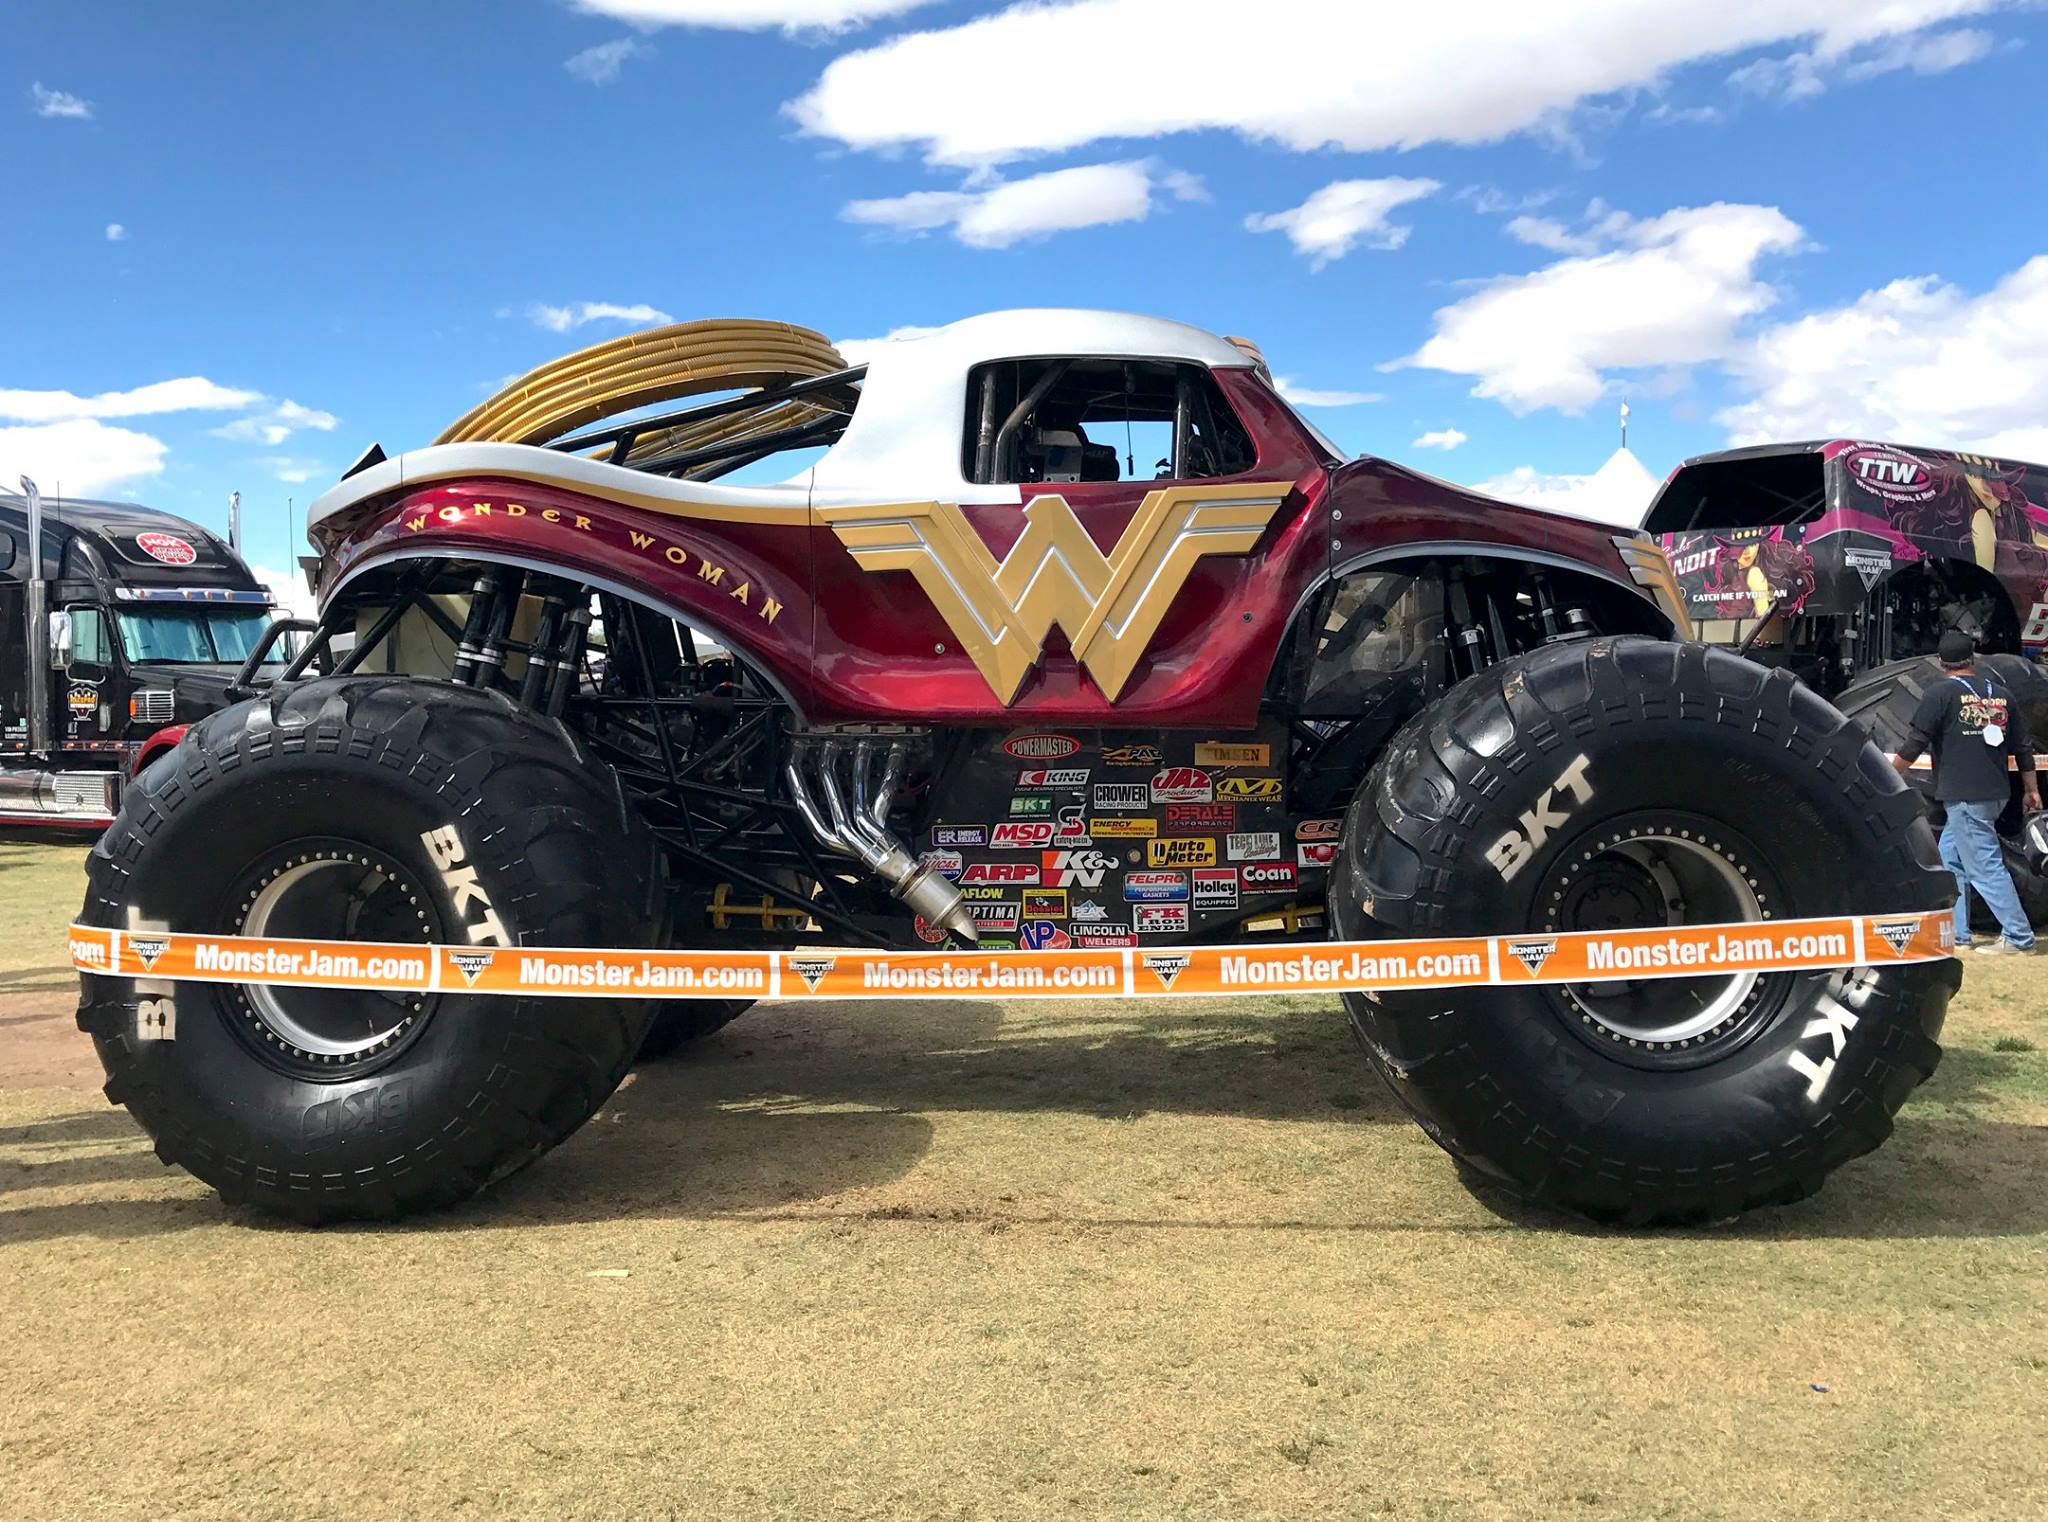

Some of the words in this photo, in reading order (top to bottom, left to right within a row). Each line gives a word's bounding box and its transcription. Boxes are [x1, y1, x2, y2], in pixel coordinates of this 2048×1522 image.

[1858, 458, 1918, 484] TTW
[406, 503, 592, 533] WONDER
[628, 530, 784, 625] WOMAN
[1672, 546, 1721, 577] NDIT
[1693, 593, 1720, 602] CATCH
[1721, 592, 1734, 601] ME
[1735, 591, 1745, 600] IF
[1011, 738, 1073, 757] POWERMASTER
[1045, 772, 1087, 783] KING
[1152, 769, 1211, 790] JAZ
[1095, 785, 1147, 802] CROWER
[1011, 798, 1051, 813] BKT
[1168, 807, 1233, 820] DERALE
[1485, 752, 1595, 883] BKT
[993, 824, 1053, 841] MSD
[1168, 841, 1205, 852] Auto
[1163, 851, 1212, 865] Meter
[963, 865, 1039, 881] ARP
[1127, 874, 1185, 884] FEL-PRO
[1242, 865, 1292, 882] Coan
[419, 823, 512, 947] BKT
[1194, 881, 1237, 896] Holley
[961, 888, 1004, 899] AFLOW
[1072, 905, 1108, 918] PEAK
[1142, 907, 1184, 918] FK
[1021, 920, 1056, 950] VP
[1073, 926, 1126, 936] LINCOLN
[1873, 924, 1921, 934] MONSTER
[1085, 937, 1131, 946] WELDERS
[1891, 933, 1910, 942] JAM
[128, 941, 170, 951] MONSTER
[1507, 945, 1556, 956] MONSTER
[1586, 931, 1847, 970] MonsterJam.com
[194, 943, 425, 981] MonsterJam.com
[449, 956, 494, 966] MONSTER
[1143, 958, 1191, 969] MONSTER
[1521, 953, 1543, 962] JAM
[519, 957, 763, 988] MonsterJam.com
[788, 962, 834, 972] MONSTER
[1156, 966, 1178, 975] JAM
[1220, 952, 1481, 984] MonsterJam.com
[863, 961, 1116, 988] MonsterJam.com
